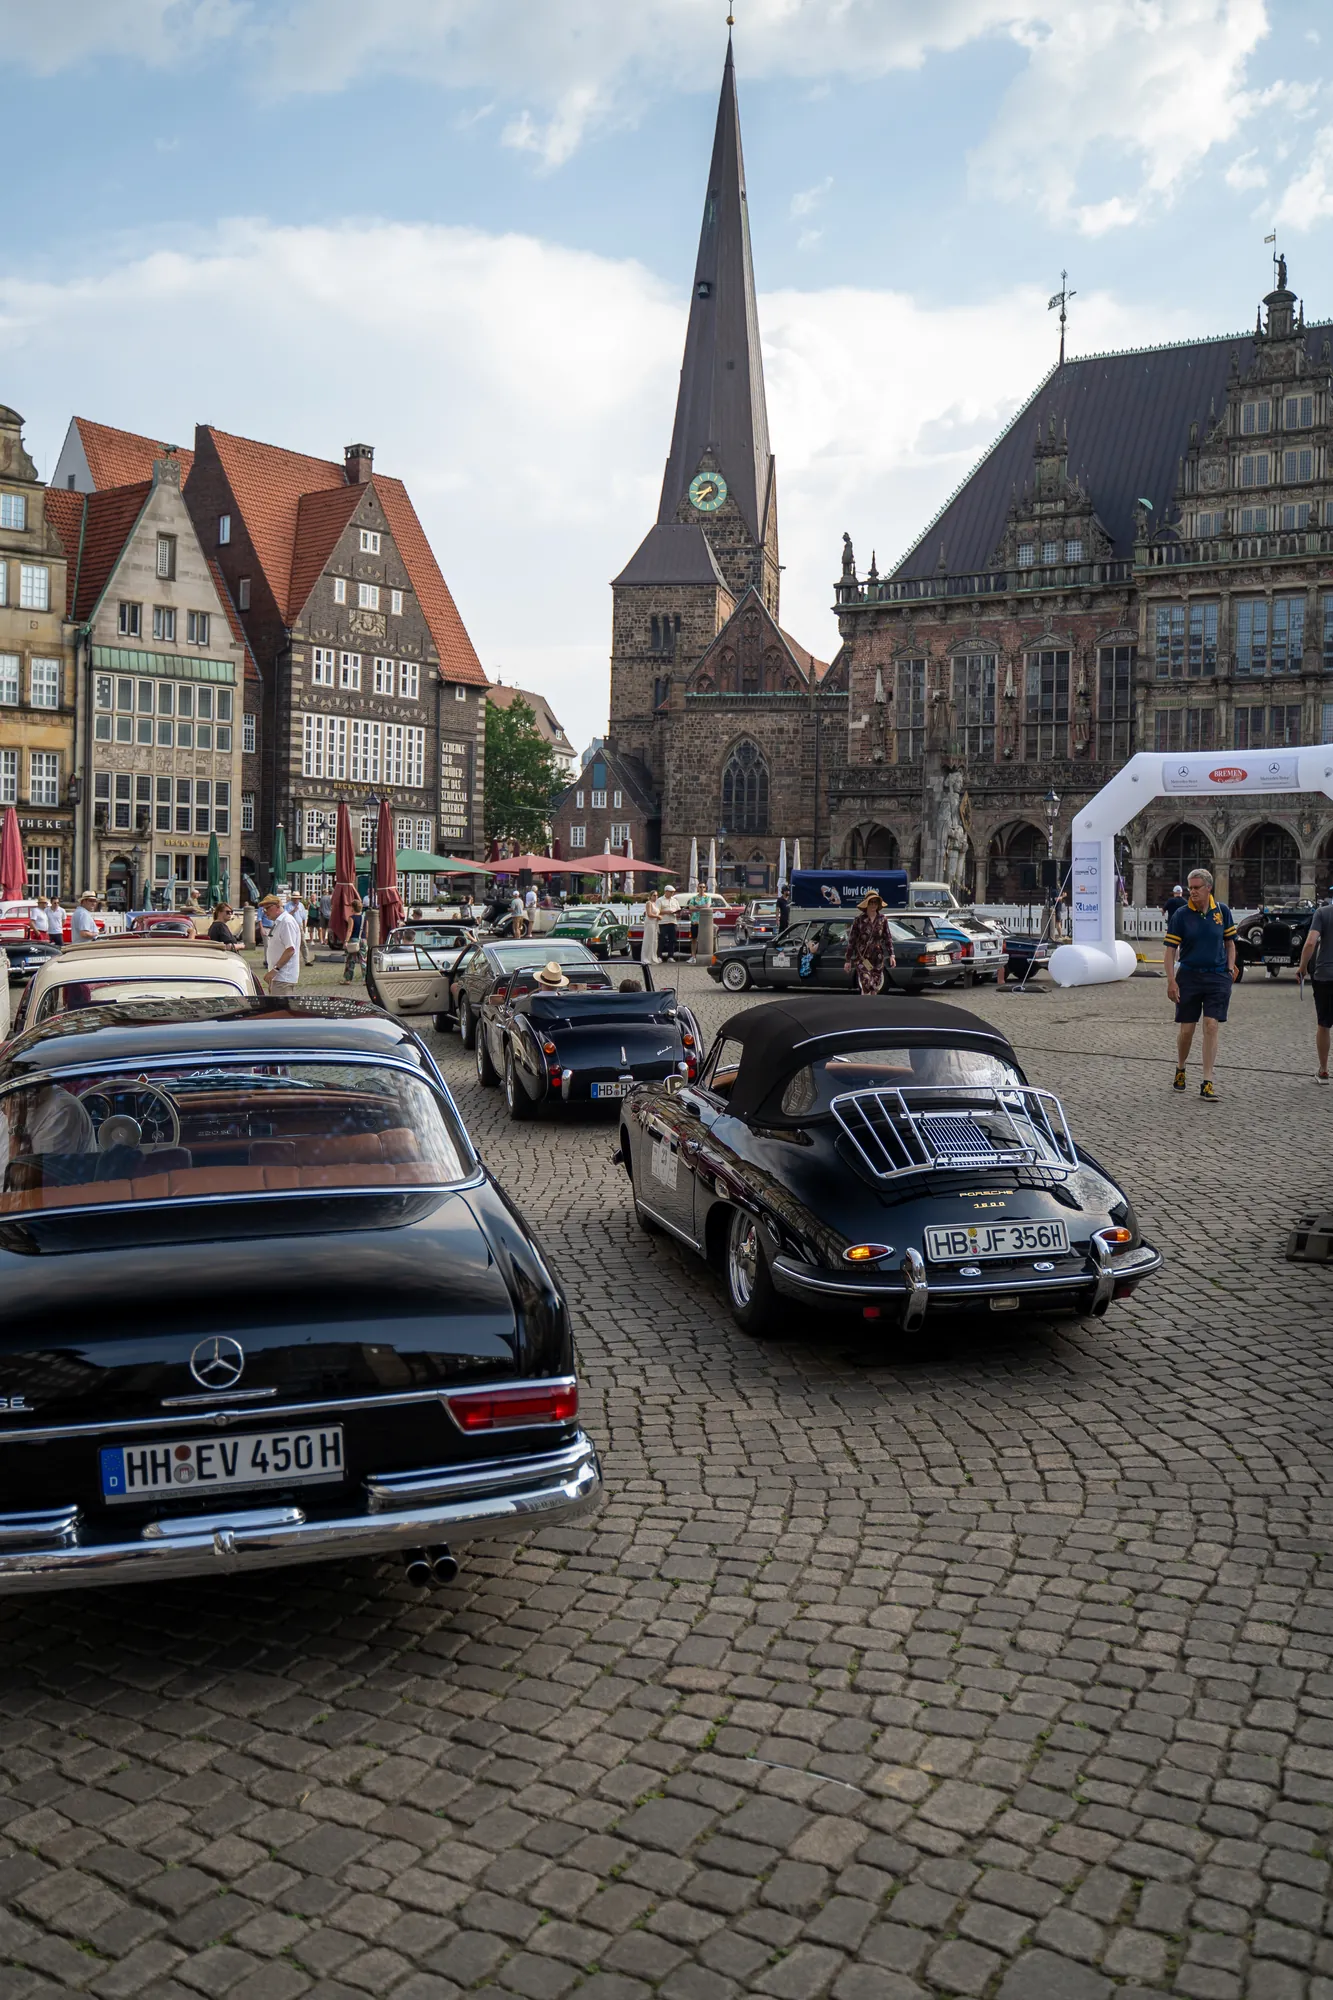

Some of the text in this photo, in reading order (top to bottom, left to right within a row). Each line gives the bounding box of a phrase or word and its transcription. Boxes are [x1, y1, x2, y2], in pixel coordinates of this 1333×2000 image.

[441, 754, 453, 765] DER
[1214, 769, 1243, 777] BREMEN
[842, 886, 859, 898] Lloyd
[598, 1084, 613, 1096] HB
[973, 1201, 1006, 1209] 1600
[933, 1224, 1062, 1256] HB JF 356H
[126, 1448, 172, 1487] HH
[195, 1441, 239, 1480] EV
[109, 1476, 118, 1487] D
